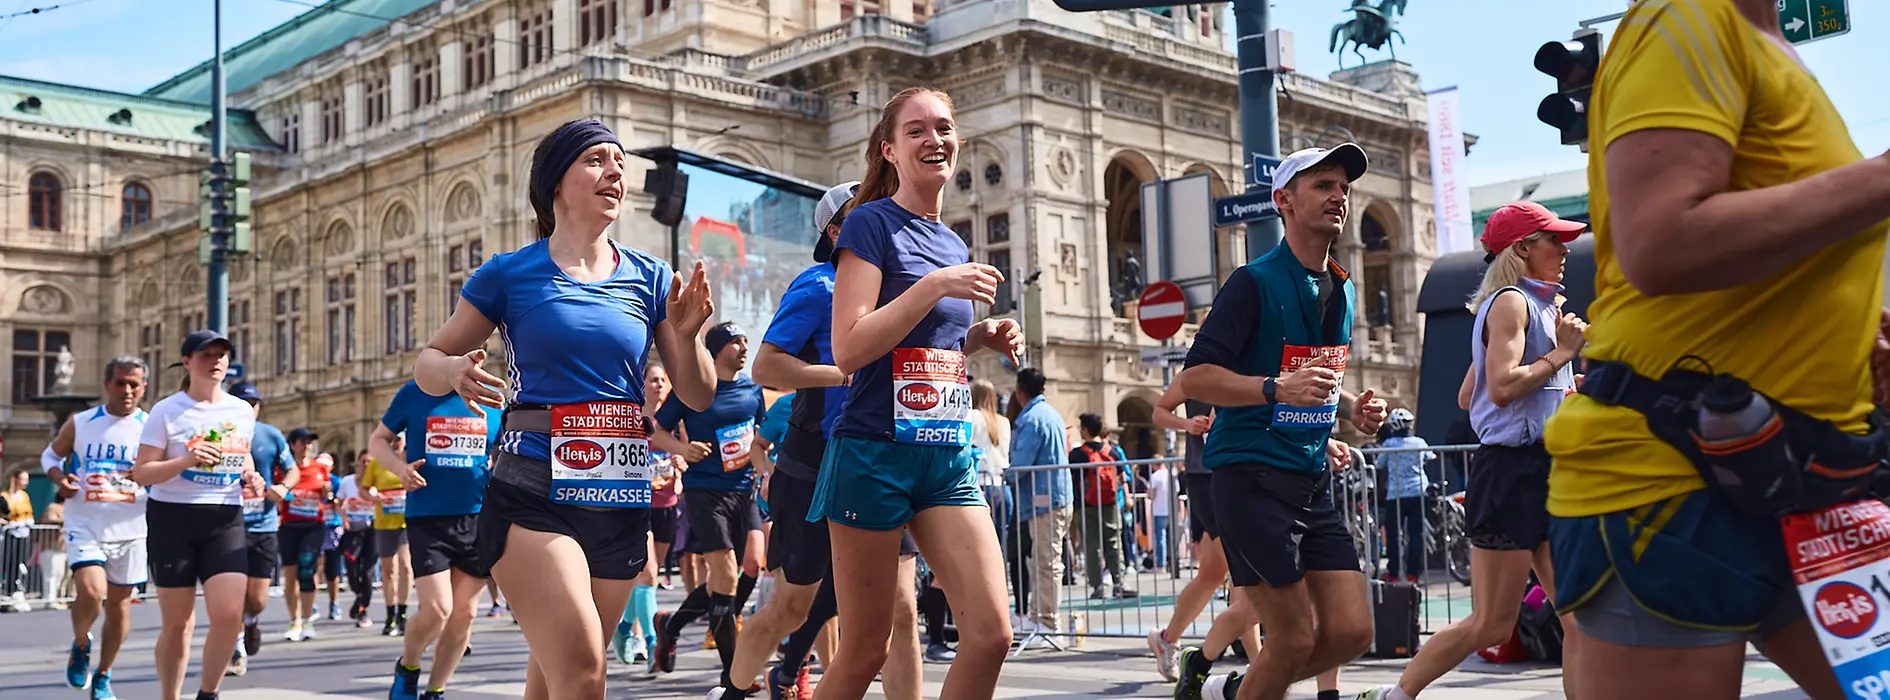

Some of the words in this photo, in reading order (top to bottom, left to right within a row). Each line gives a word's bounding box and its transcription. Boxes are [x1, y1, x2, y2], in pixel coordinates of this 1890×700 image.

[902, 389, 938, 405] Hervis
[589, 403, 633, 417] WIENER
[562, 415, 633, 429] STÄDTISCHE
[454, 436, 485, 449] 17392
[915, 427, 957, 443] ERSTE
[86, 443, 138, 461] LIBY
[560, 446, 602, 464] Hervis
[437, 457, 464, 467] ERSTE
[624, 470, 643, 479] Simone
[555, 487, 642, 503] SPARKASSE
